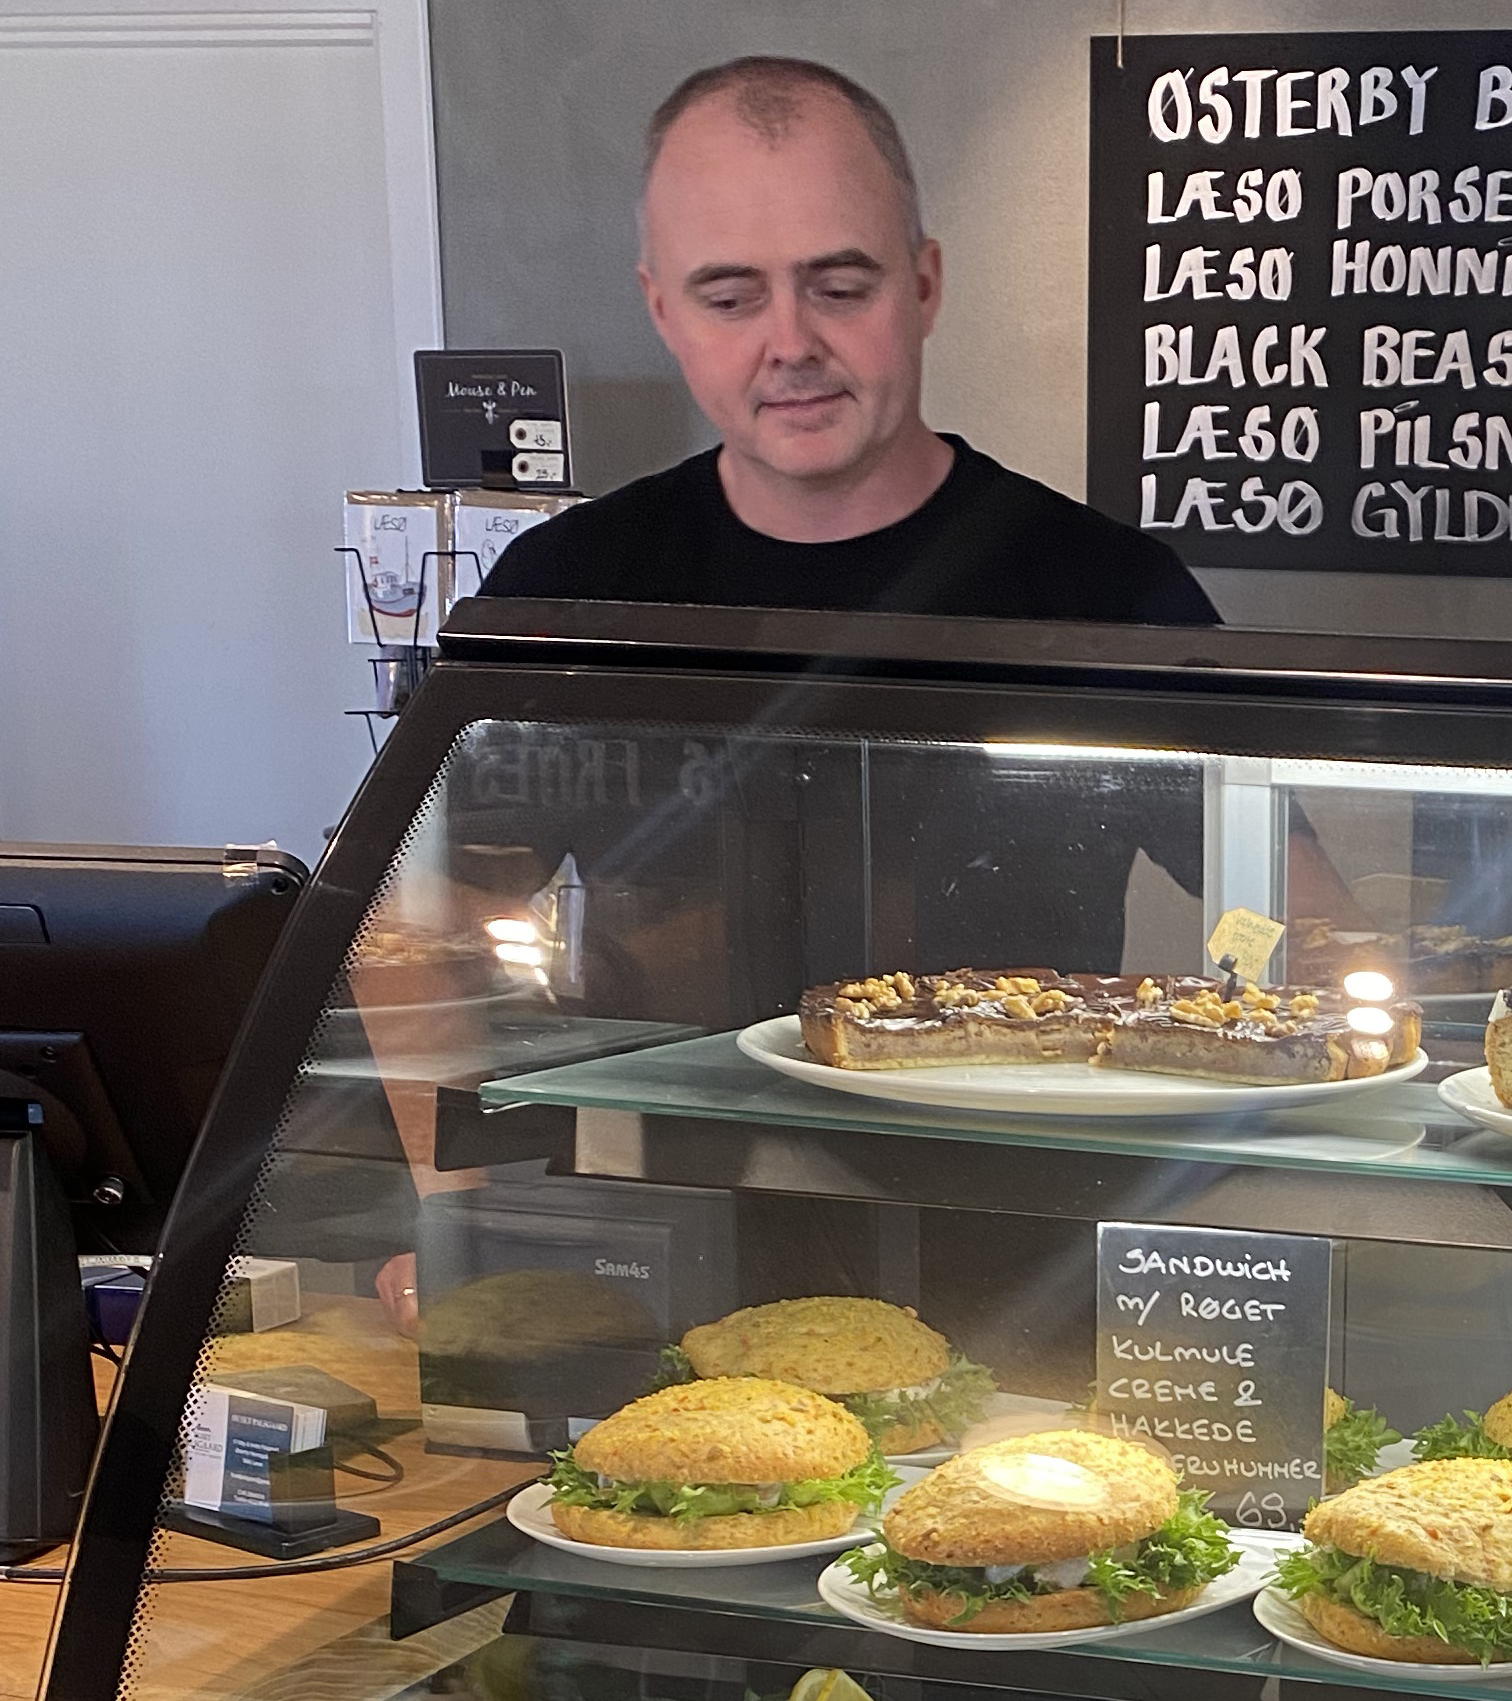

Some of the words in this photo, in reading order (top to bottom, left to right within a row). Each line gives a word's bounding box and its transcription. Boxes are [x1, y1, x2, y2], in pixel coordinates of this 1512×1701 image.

[1148, 65, 1438, 145] ØSTERBY
[1146, 168, 1303, 225] LÆSØ
[1144, 244, 1295, 302] LÆSØ
[1144, 324, 1329, 388] BLACK
[445, 381, 493, 398] Mouse
[497, 381, 506, 397] &
[511, 381, 537, 397] Pen
[1142, 401, 1320, 462] LÆSØ
[1140, 473, 1323, 535] LÆSØ
[1179, 1291, 1286, 1322] RØGET
[1108, 1377, 1218, 1402] CREME
[1233, 1379, 1262, 1408] &
[1110, 1412, 1257, 1443] HAKKEDE
